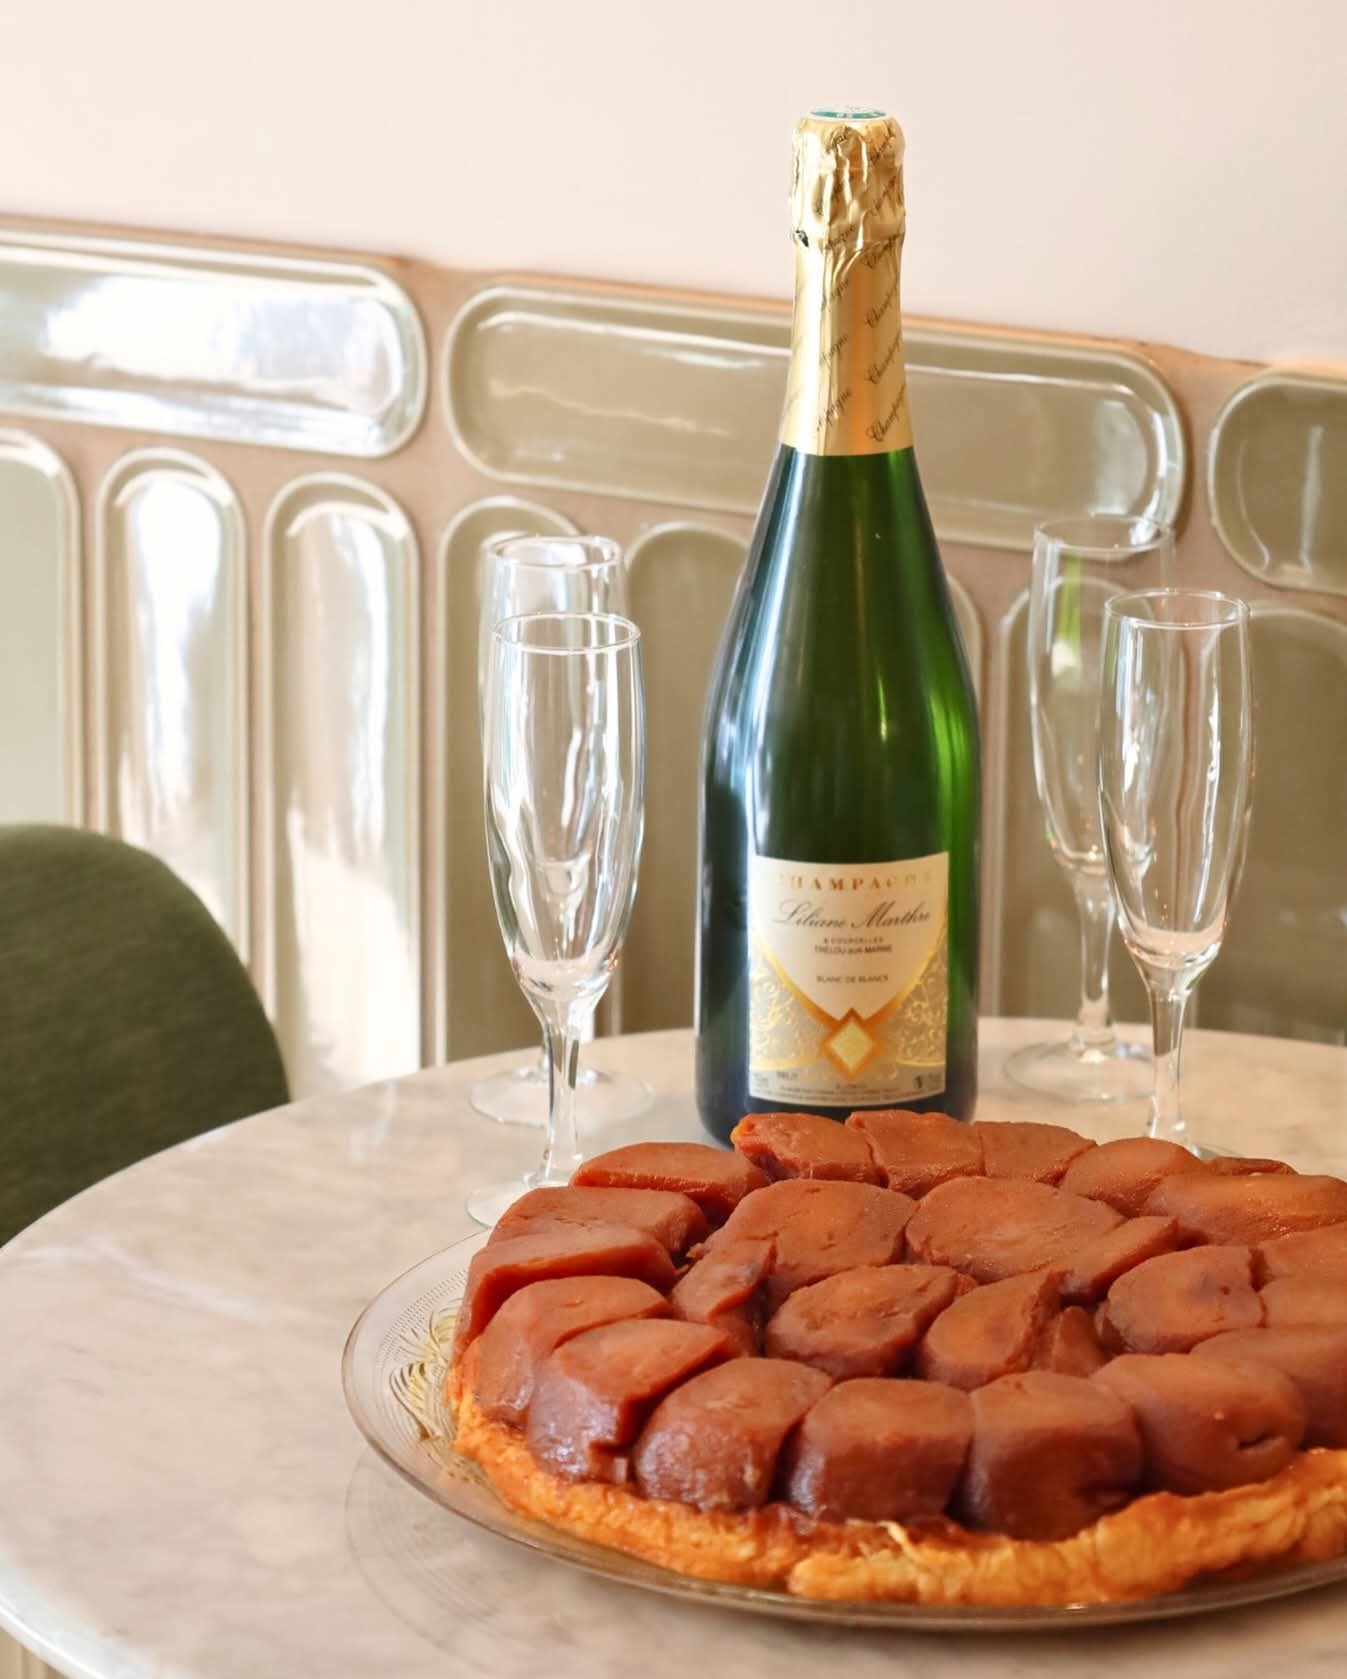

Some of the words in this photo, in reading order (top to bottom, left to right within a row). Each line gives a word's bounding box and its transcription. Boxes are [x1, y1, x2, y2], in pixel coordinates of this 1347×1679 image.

[775, 872, 932, 892] HAMPAN
[773, 897, 847, 929] Liliane
[845, 975, 857, 984] DE
